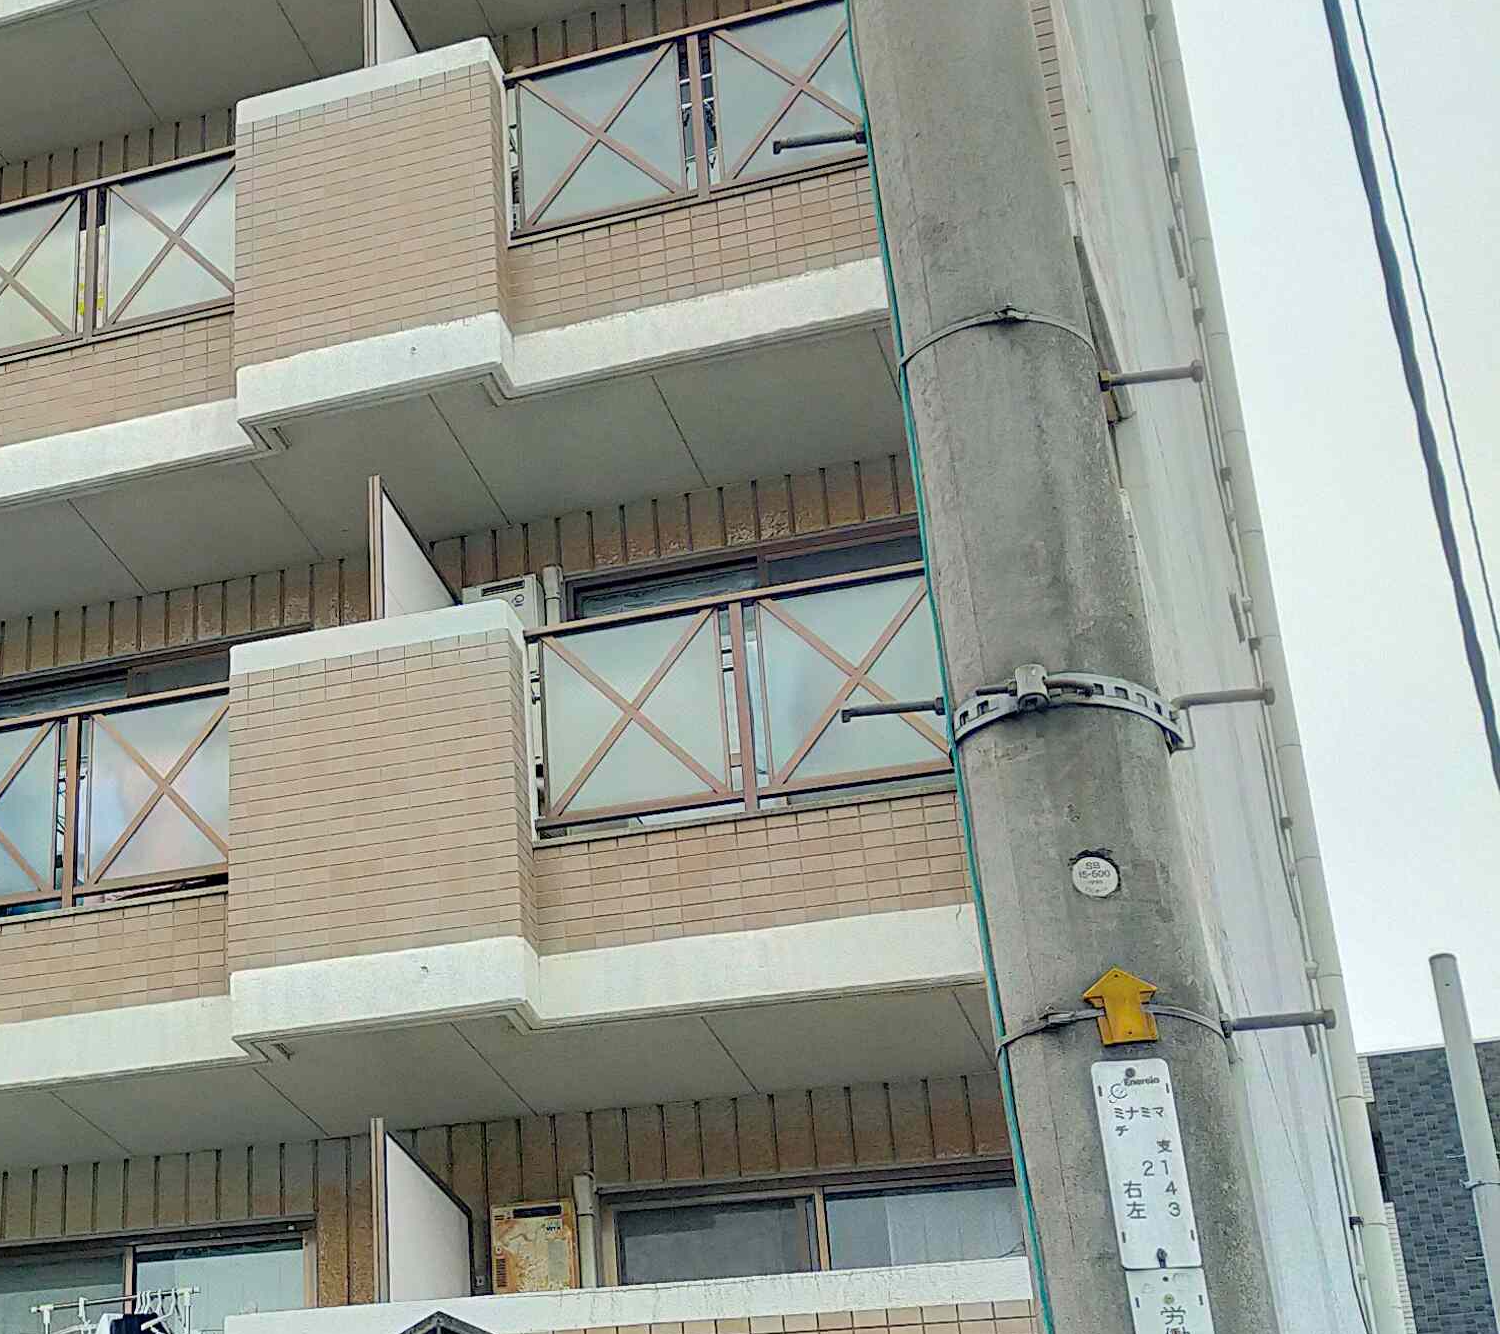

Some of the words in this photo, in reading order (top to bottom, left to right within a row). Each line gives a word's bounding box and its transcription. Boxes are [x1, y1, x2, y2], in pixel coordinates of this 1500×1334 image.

[1114, 1106, 1165, 1120] ミナミマ
[1123, 1180, 1142, 1199] 右
[1165, 1181, 1178, 1196] 4
[1126, 1201, 1147, 1220] 左
[1168, 1202, 1181, 1217] 3
